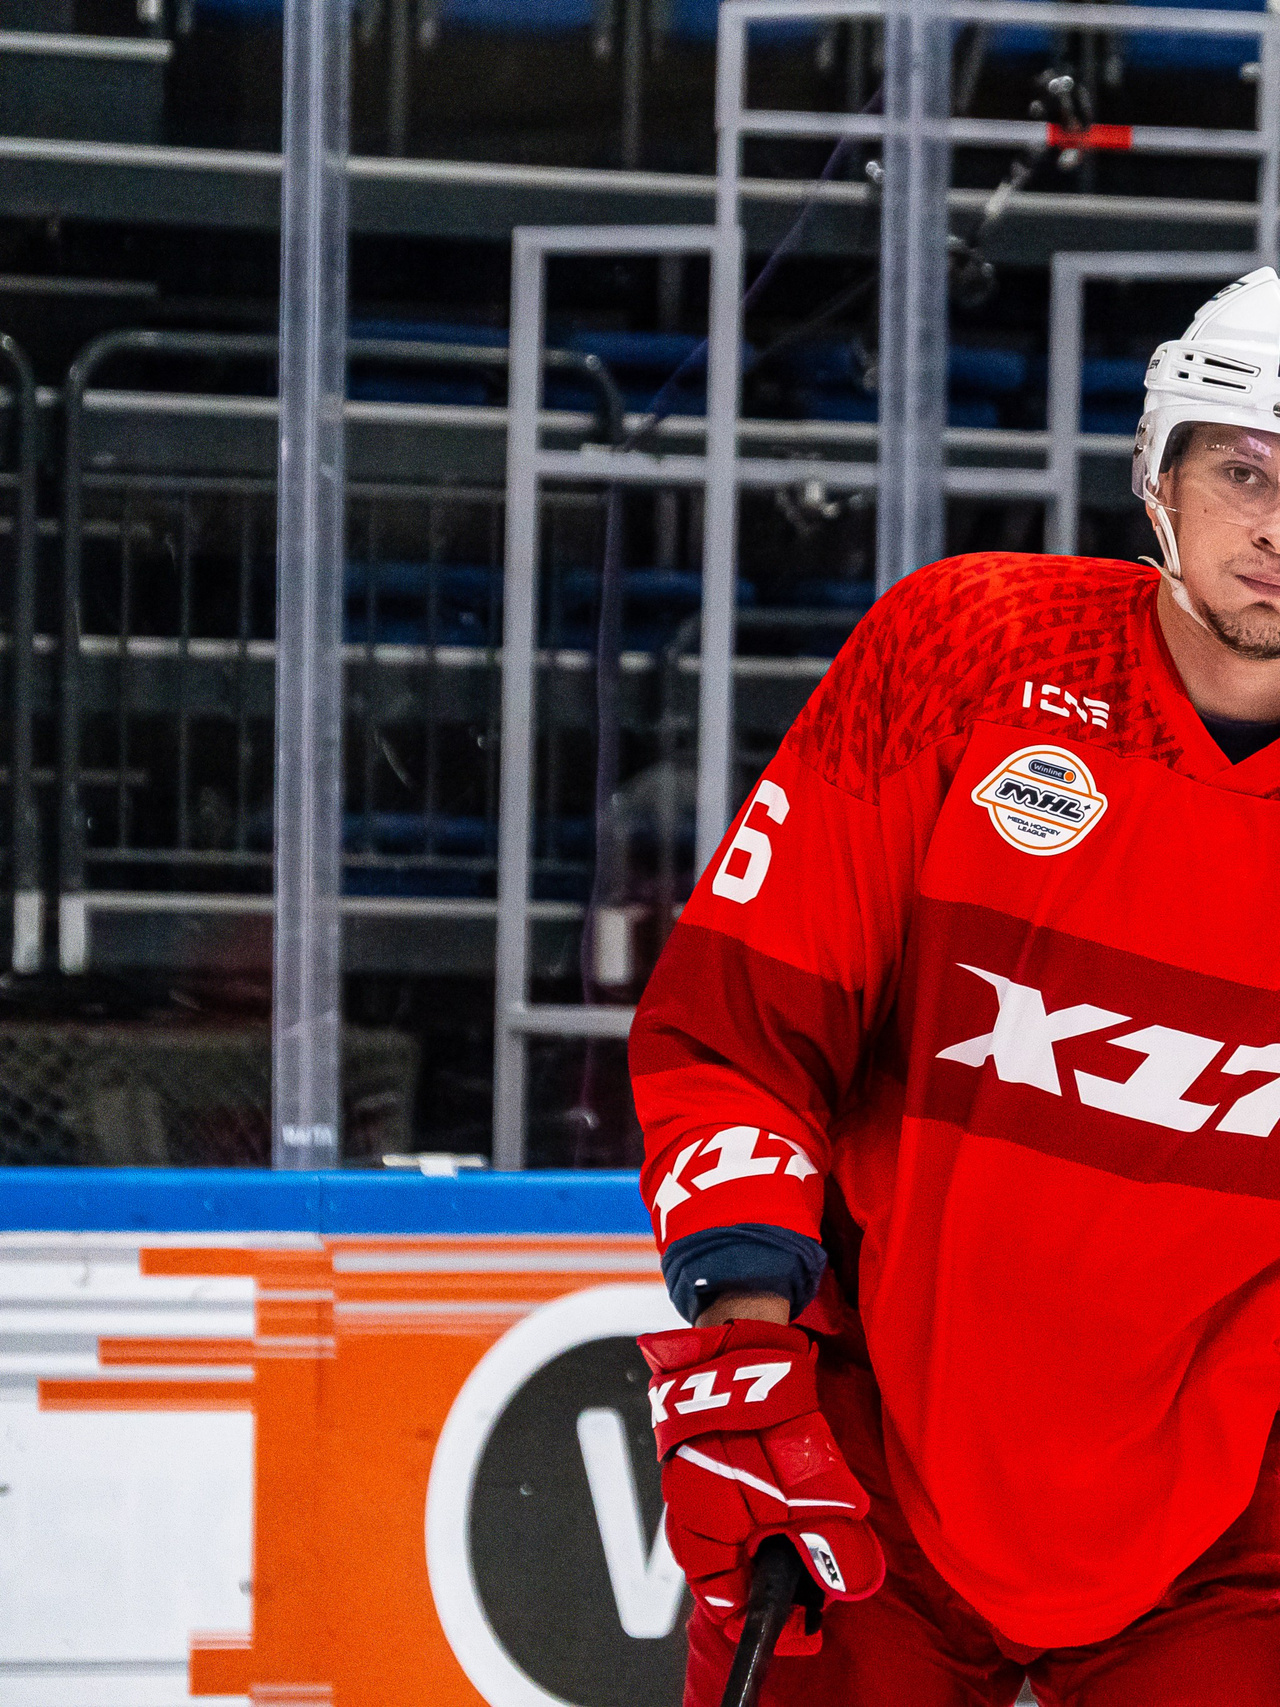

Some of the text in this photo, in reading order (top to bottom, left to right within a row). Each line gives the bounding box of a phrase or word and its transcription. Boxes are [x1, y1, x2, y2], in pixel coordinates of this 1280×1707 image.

[1033, 762, 1064, 778] Winline
[999, 781, 1082, 820] MHL
[1007, 815, 1061, 837] MEDIA HOCKEY
[1017, 825, 1047, 839] LEAGUE
[711, 779, 791, 905] 6
[647, 1361, 792, 1429] X17
